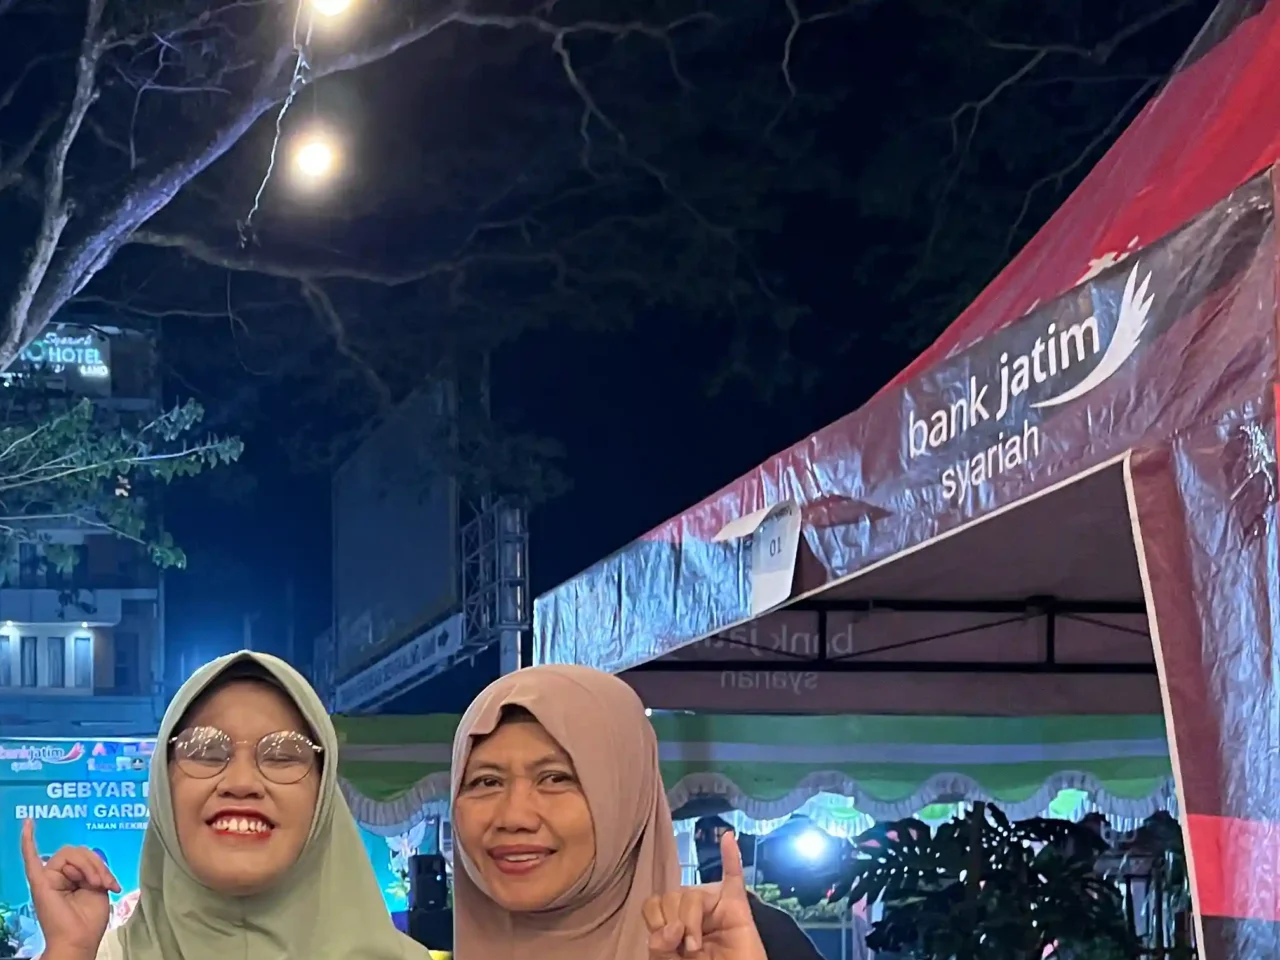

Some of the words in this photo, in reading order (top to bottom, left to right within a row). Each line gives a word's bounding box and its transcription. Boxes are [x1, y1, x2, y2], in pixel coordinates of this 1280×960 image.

[48, 346, 104, 365] HOTEL
[941, 421, 1039, 505] syariah
[46, 781, 136, 798] GEBYAR
[15, 804, 87, 819] BINAAN
[86, 822, 117, 830] TAMAN
